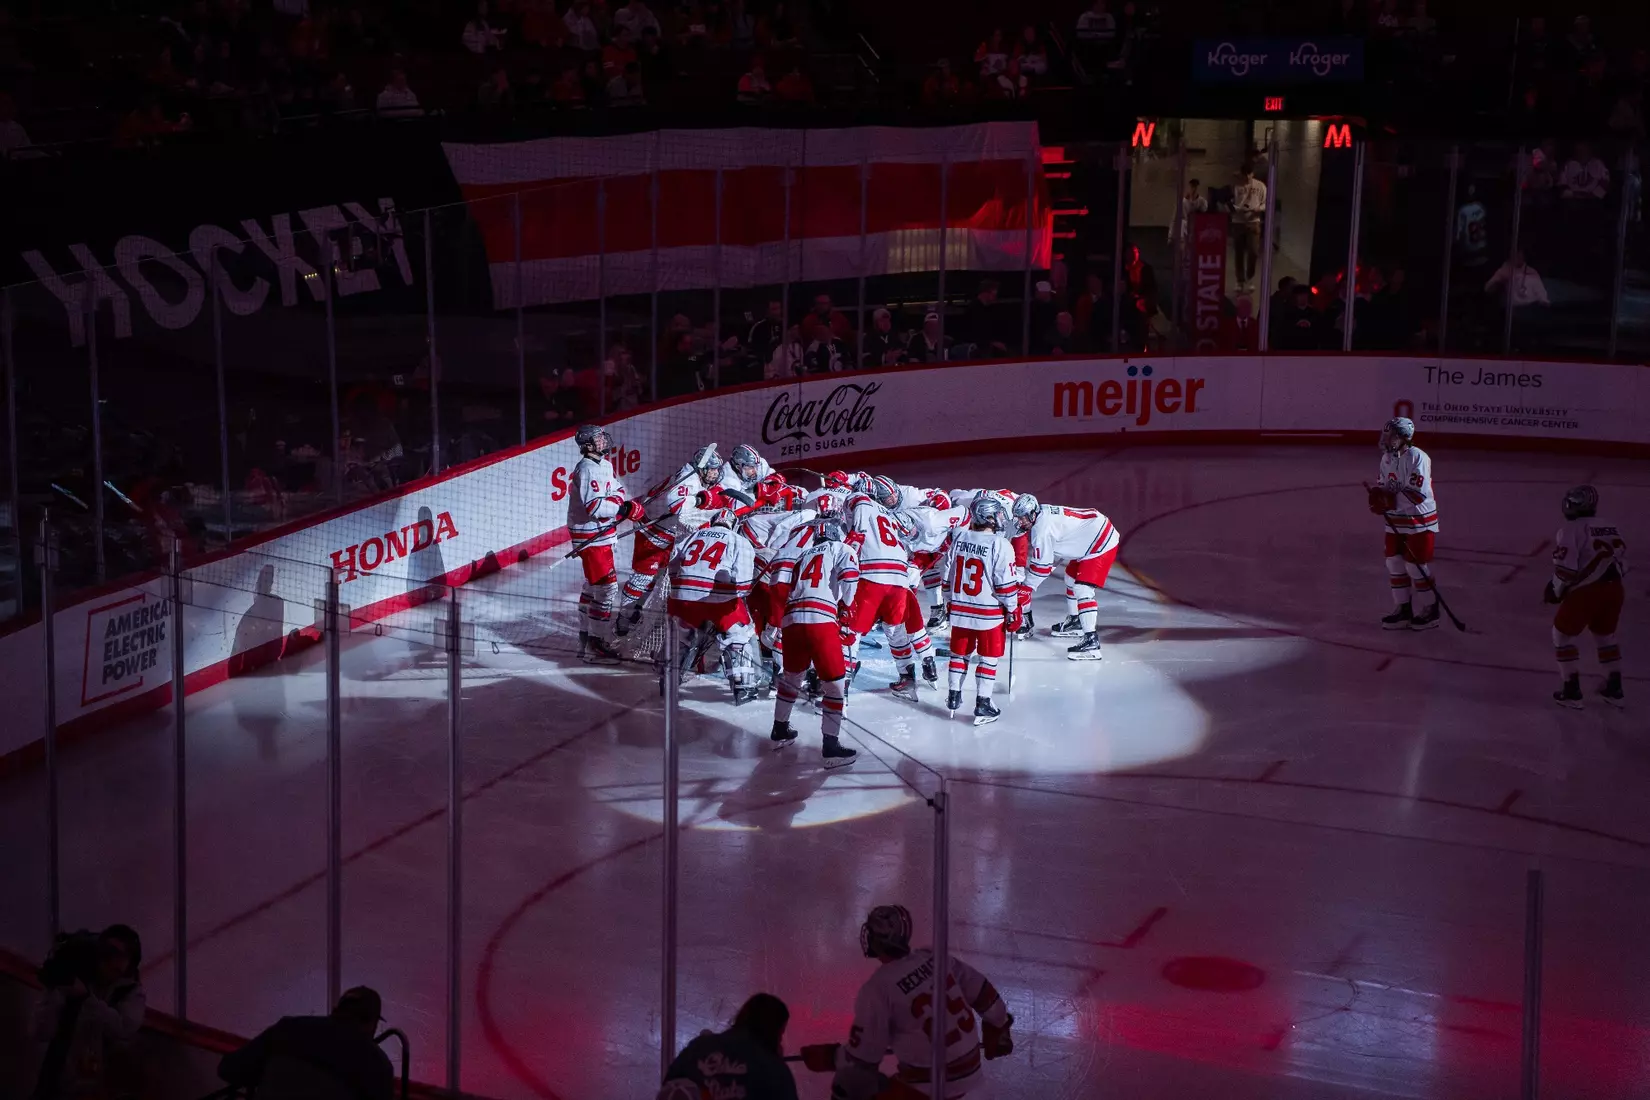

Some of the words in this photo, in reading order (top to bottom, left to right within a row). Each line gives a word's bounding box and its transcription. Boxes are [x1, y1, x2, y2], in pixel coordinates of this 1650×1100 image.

[1207, 42, 1268, 76] Kroger
[1289, 42, 1350, 76] Kroger
[1264, 96, 1283, 111] EXIT
[20, 197, 414, 348] HOCKEY
[1196, 254, 1223, 331] STATE
[1424, 366, 1464, 385] The
[1471, 367, 1543, 388] James
[1053, 365, 1205, 426] meijer
[762, 382, 883, 445] Coca-Cola
[1420, 414, 1499, 426] COMPREHENSIVE
[1501, 417, 1540, 428] CANCER
[1541, 420, 1579, 430] CENTER
[781, 443, 811, 456] ZERO
[815, 437, 855, 451] SUGAR
[590, 479, 600, 493] 9
[330, 512, 459, 585] HONDA
[697, 530, 728, 540] HERBST
[956, 540, 990, 557] FONTAINE
[681, 539, 727, 571] 34
[1552, 545, 1568, 561] 23
[800, 553, 824, 588] 4
[953, 555, 986, 596] 13
[104, 600, 172, 639] AMERICA
[104, 621, 166, 662] ELECTRIC
[102, 648, 157, 685] POWER
